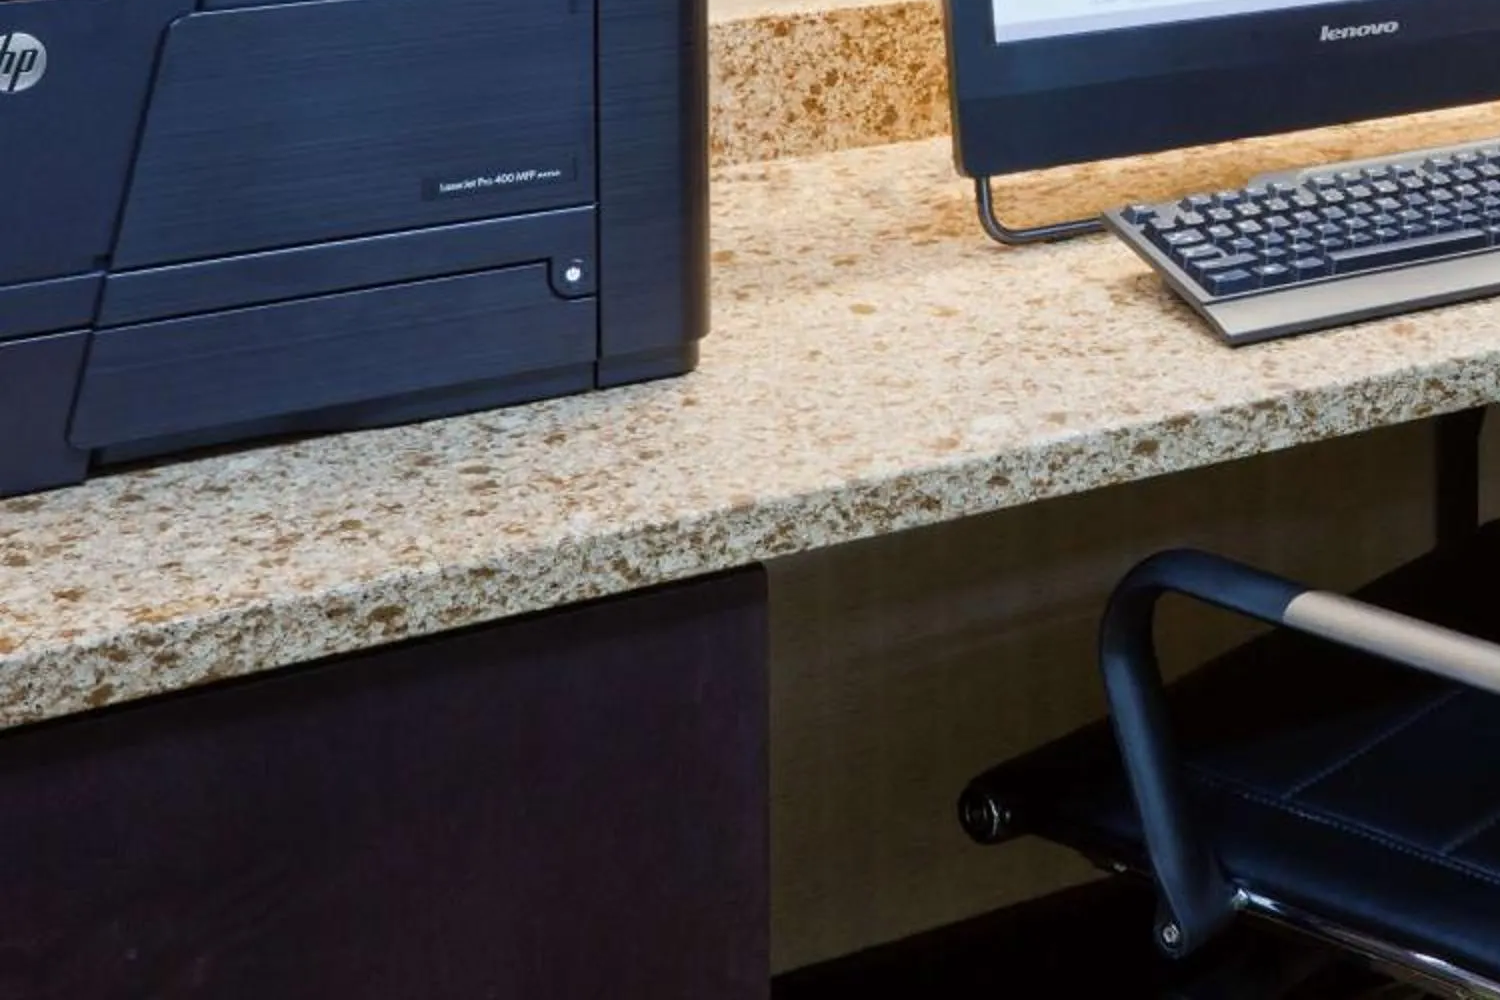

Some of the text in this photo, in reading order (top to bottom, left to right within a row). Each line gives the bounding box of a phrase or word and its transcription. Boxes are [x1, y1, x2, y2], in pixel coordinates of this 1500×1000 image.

[1320, 21, 1399, 41] lenovo
[0, 32, 39, 93] hp
[494, 173, 515, 184] 400
